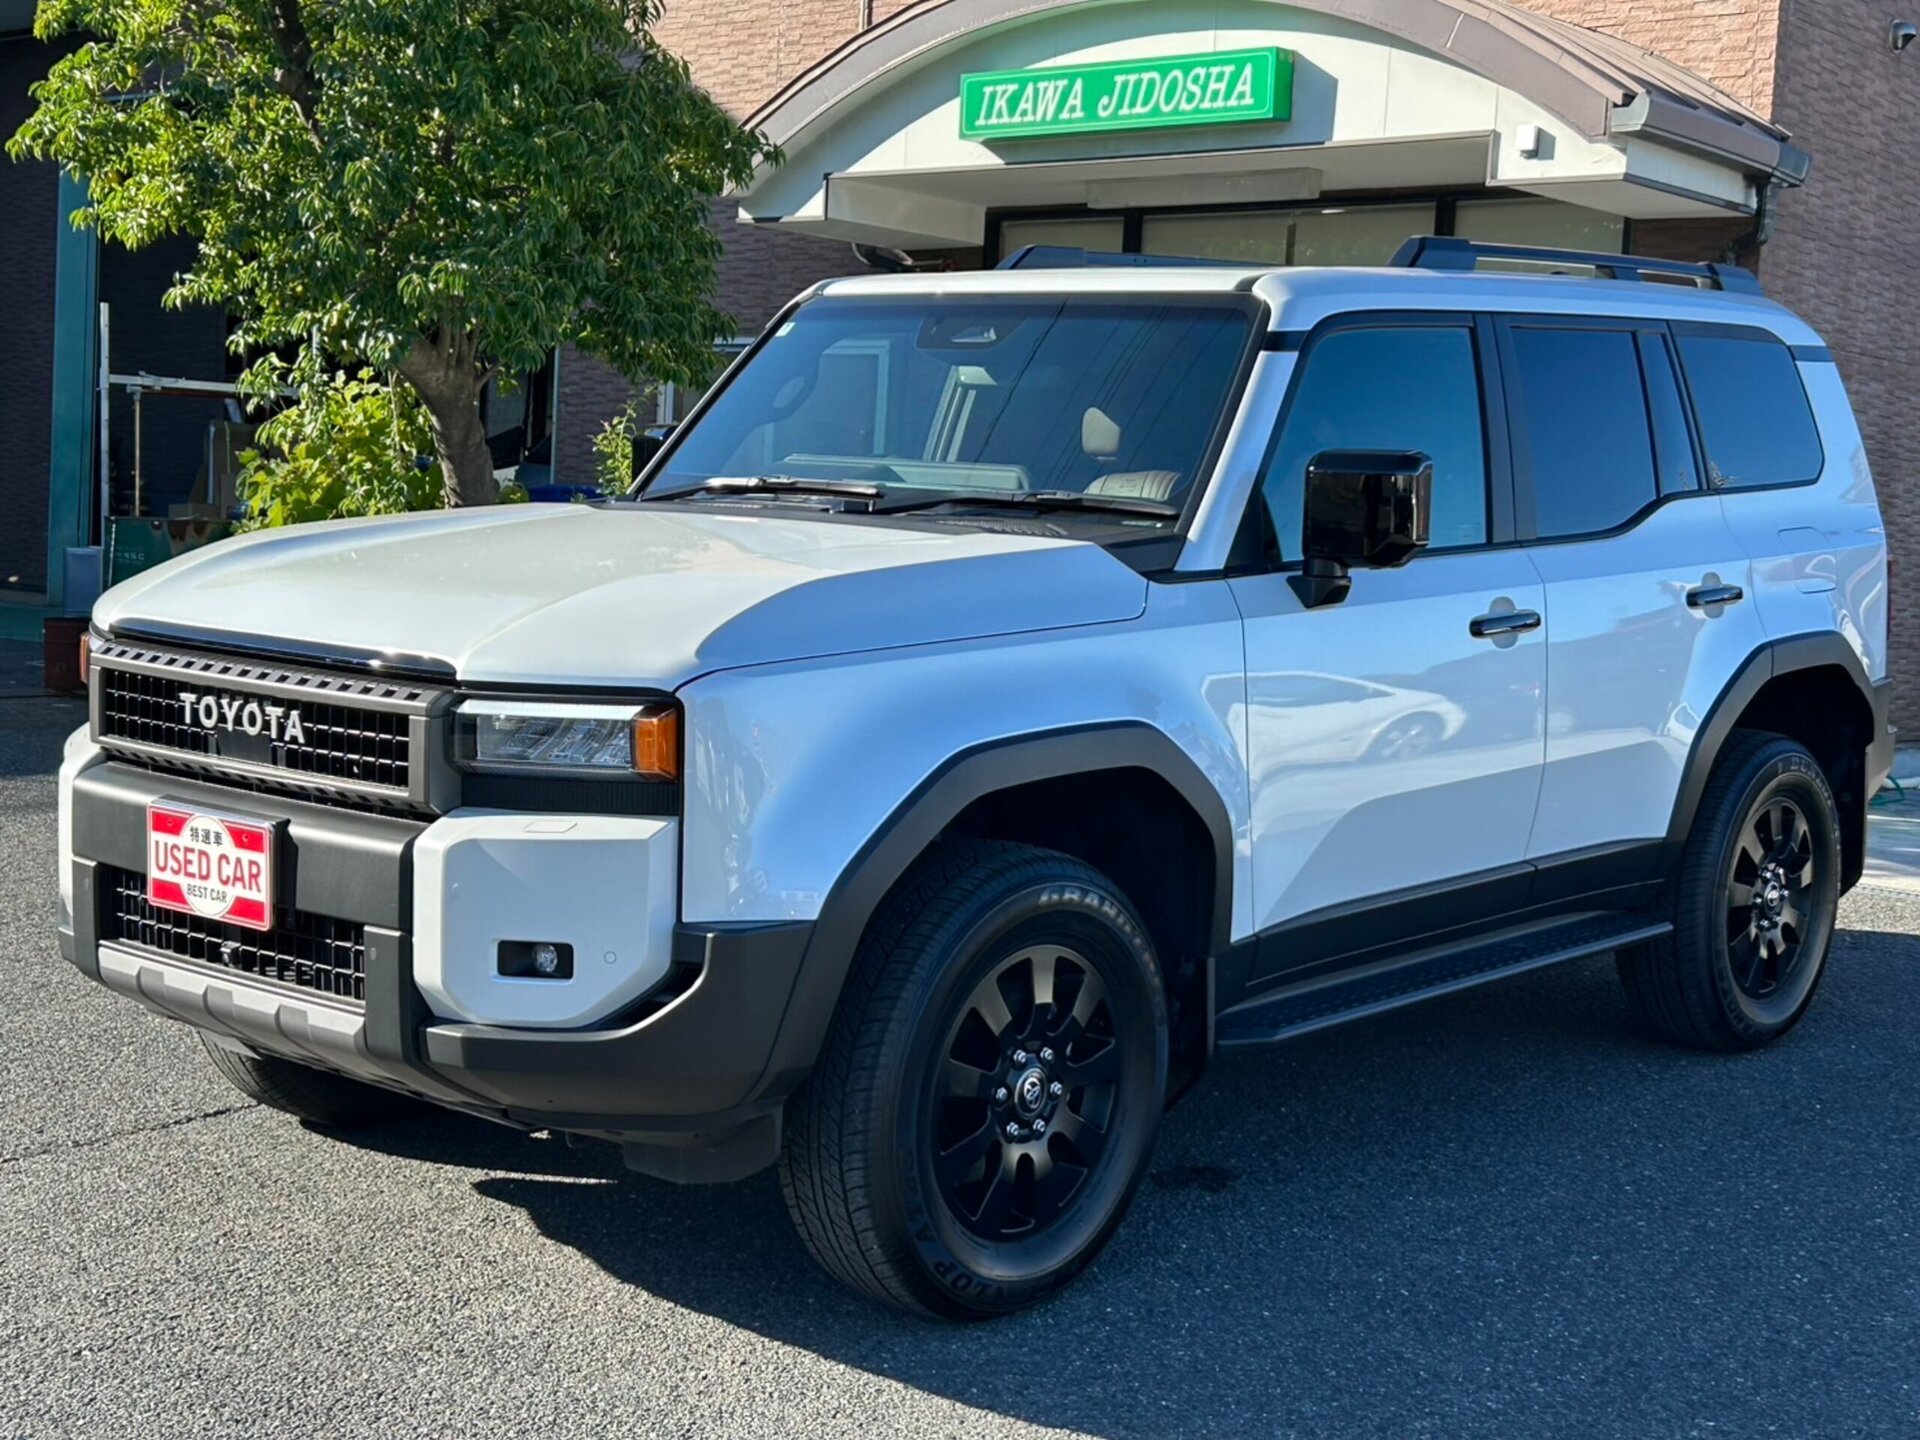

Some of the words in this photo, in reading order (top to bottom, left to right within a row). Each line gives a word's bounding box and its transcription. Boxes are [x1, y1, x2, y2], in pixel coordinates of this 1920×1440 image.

[975, 77, 1085, 127] IKAWA
[1097, 62, 1254, 117] JIDOSHA
[179, 692, 305, 743] TOYOTA
[190, 826, 223, 846] 特選車
[155, 840, 211, 881] USED
[217, 853, 262, 893] CAR
[187, 883, 208, 898] BEST
[210, 889, 227, 903] CAR
